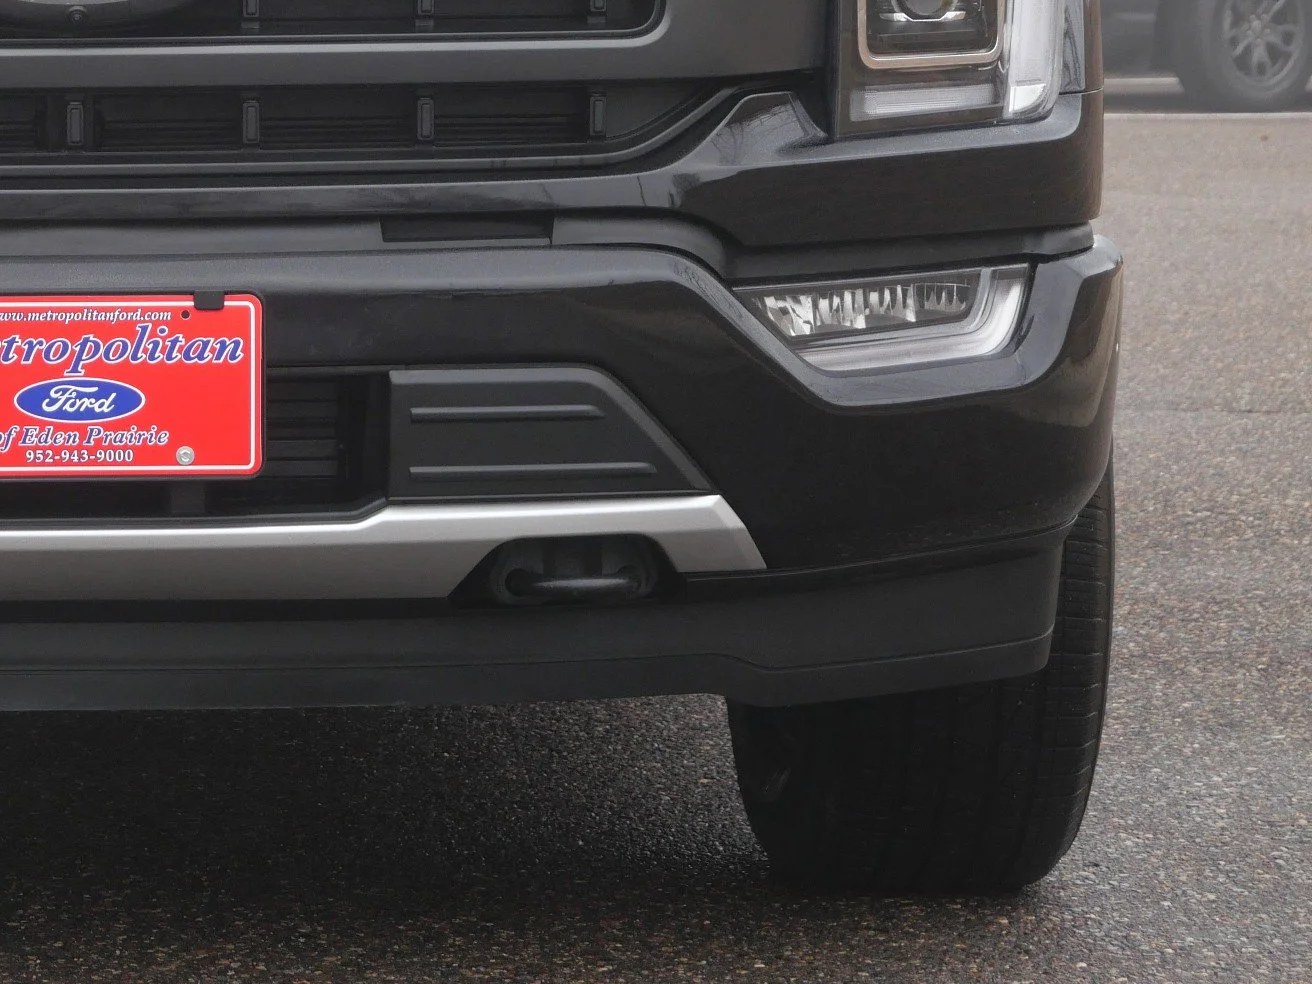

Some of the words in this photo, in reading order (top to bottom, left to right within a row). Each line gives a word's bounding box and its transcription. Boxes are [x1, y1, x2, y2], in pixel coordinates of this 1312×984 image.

[41, 384, 116, 414] Ford
[19, 425, 80, 446] Eden
[83, 425, 170, 446] Prairie
[25, 449, 134, 463] 952-943-9000
